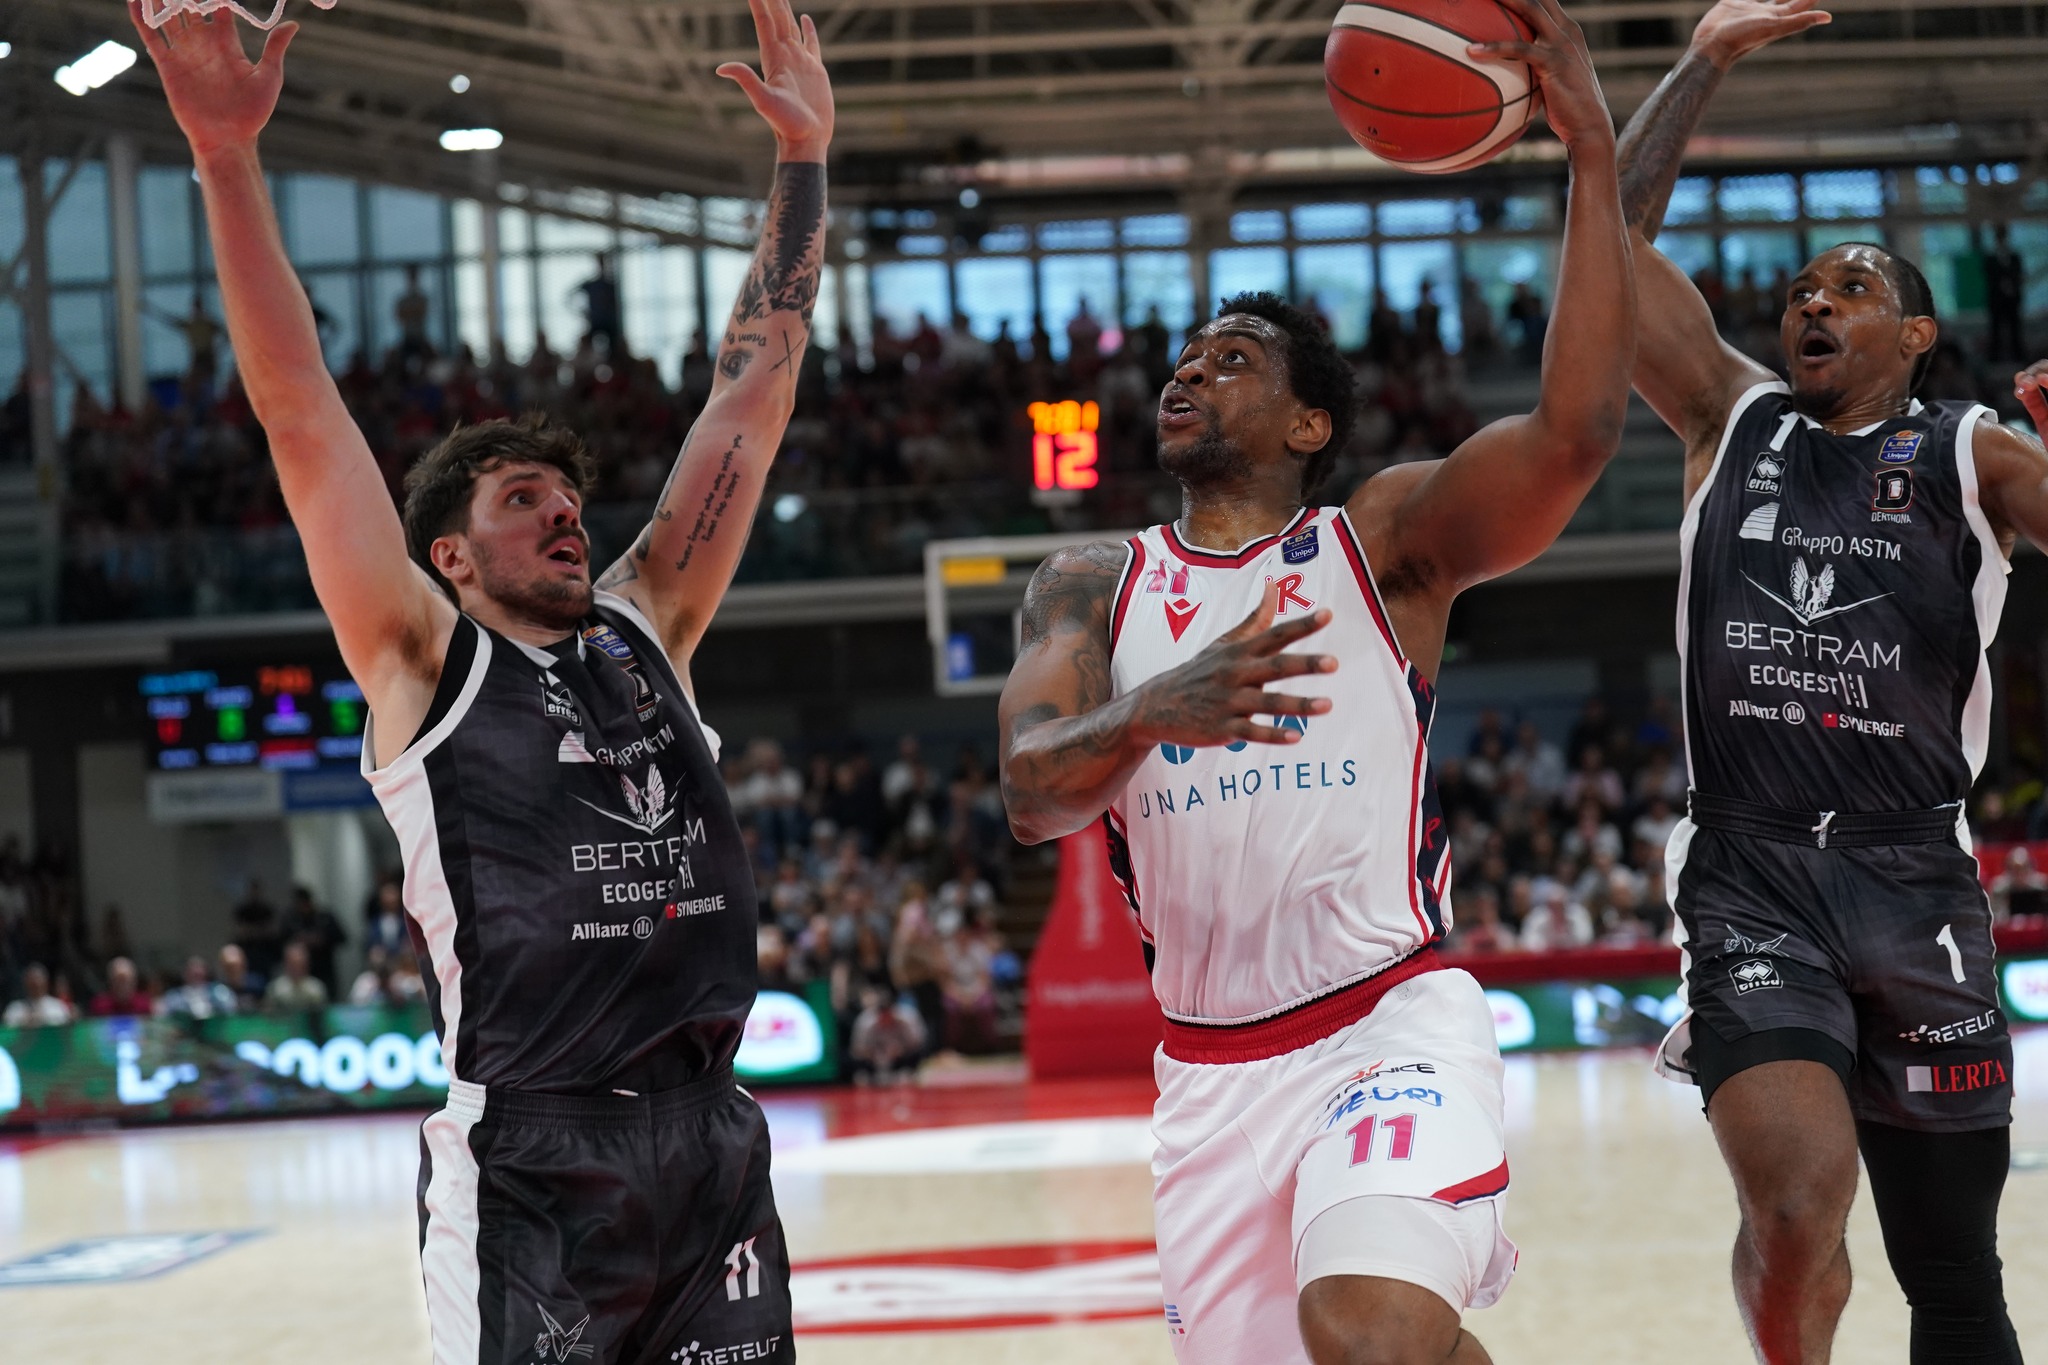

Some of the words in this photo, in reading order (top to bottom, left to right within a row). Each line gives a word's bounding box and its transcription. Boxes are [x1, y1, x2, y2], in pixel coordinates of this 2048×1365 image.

[1768, 411, 1801, 452] 1
[1032, 430, 1099, 491] 12
[1886, 452, 1910, 460] Unipol
[1871, 511, 1912, 524] DERTHONA
[1286, 532, 1314, 546] LBA
[1291, 546, 1315, 559] Unipol
[1782, 526, 1844, 555] GRUPPO
[1848, 536, 1901, 562] ASTM
[1725, 620, 1901, 672] BERTRAM
[1749, 664, 1838, 696] ECOGEST
[1729, 699, 1780, 720] Allianz
[1838, 713, 1905, 738] SYNERGIE
[1138, 783, 1205, 819] UNA
[1218, 758, 1357, 802] HOTELS
[676, 894, 727, 918] SYNERGIE
[571, 922, 630, 941] Allianz
[1935, 923, 1967, 984] 1
[1927, 1009, 1996, 1043] RETELIT
[1932, 1058, 2007, 1092] LERTA
[1345, 1112, 1418, 1169] 11
[724, 1236, 760, 1302] 11
[698, 1335, 781, 1365] RETELIT
